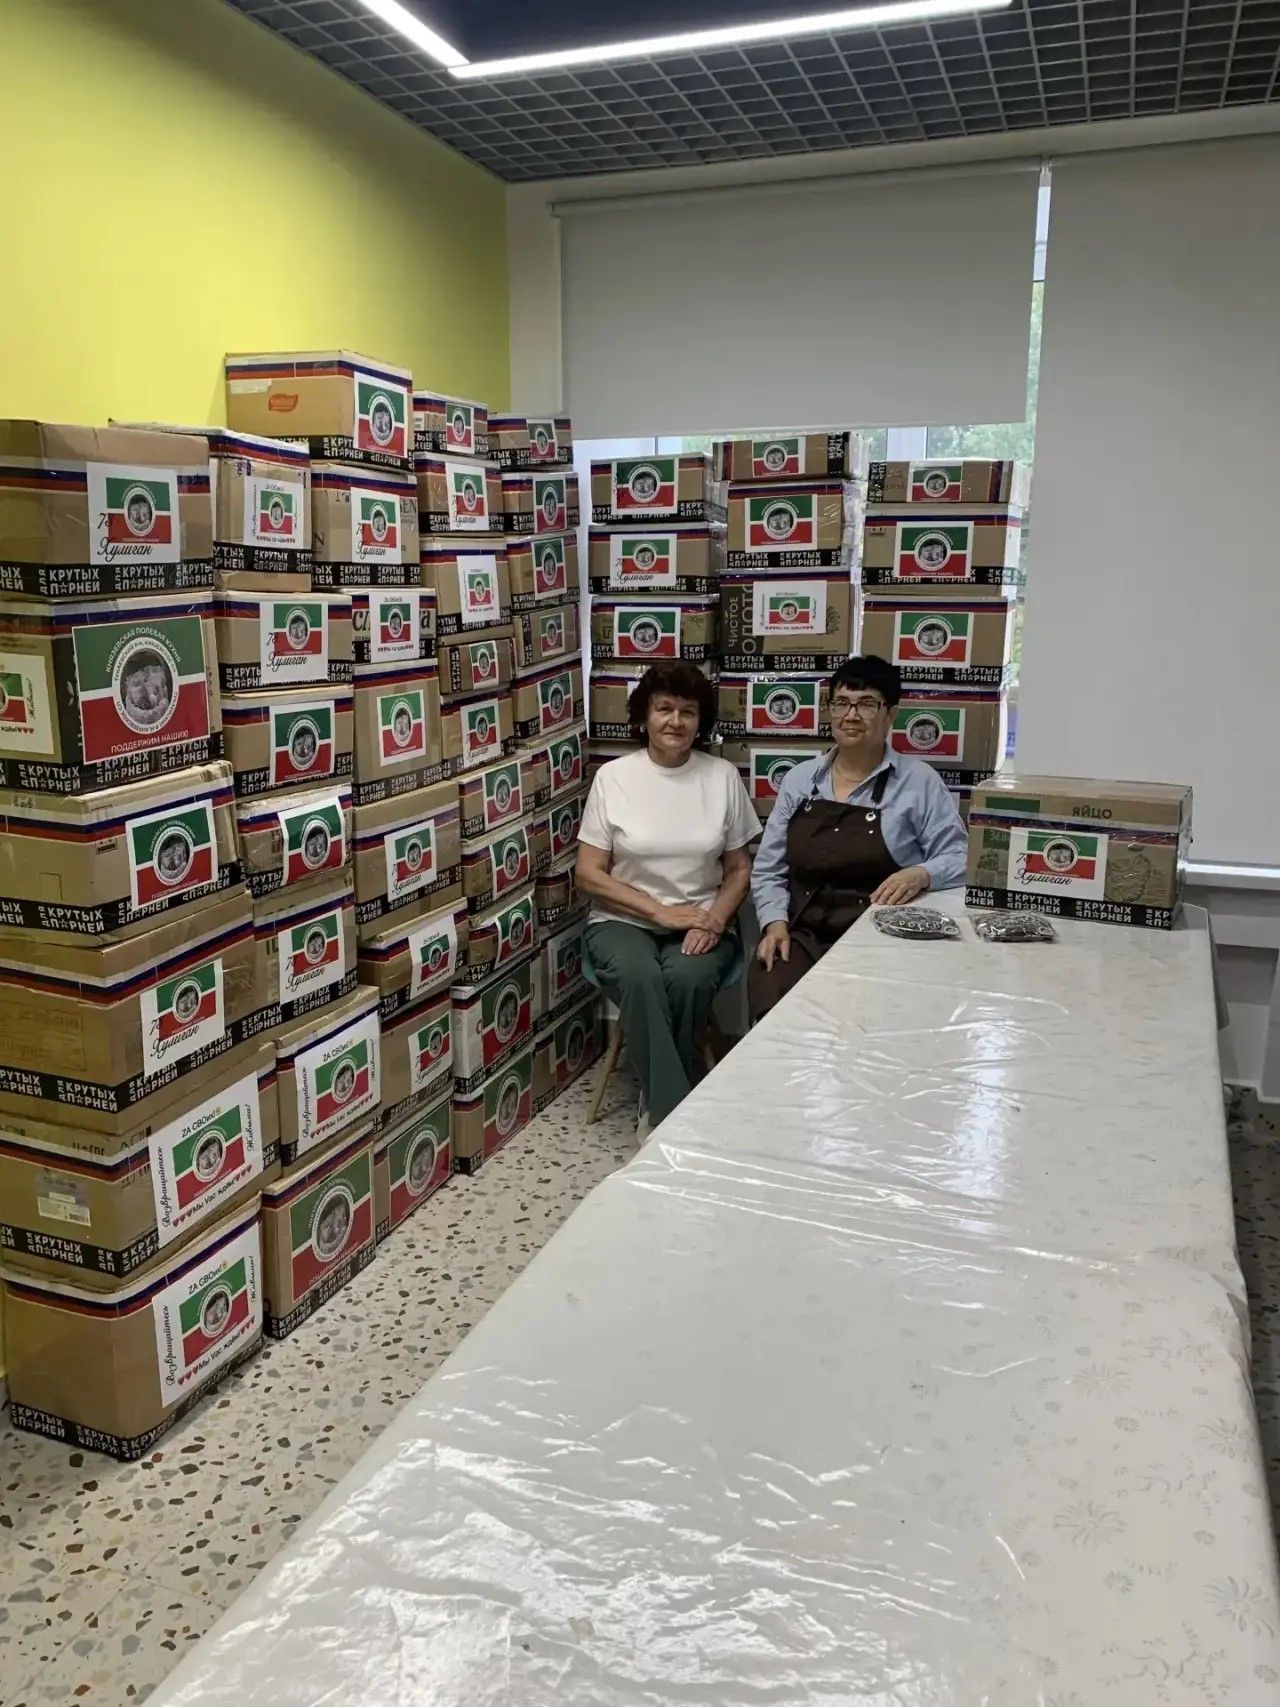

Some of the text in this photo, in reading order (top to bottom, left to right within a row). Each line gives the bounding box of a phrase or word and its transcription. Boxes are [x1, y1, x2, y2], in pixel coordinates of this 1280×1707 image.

[97, 536, 152, 562] Хулиган
[50, 568, 100, 582] КРУТЫХ
[122, 566, 165, 577] КРУТЫХ
[182, 563, 213, 575] КРУТЫ
[728, 597, 739, 647] ЧИСТОЕ
[234, 668, 261, 678] КРУТЫ
[961, 667, 1000, 675] КРУТЫХ
[111, 730, 189, 753] ПОДДЕРЖИМ НАШИХ!
[28, 765, 80, 779] КРУТЫХ
[1072, 805, 1113, 819] ЯЙЦО
[1014, 868, 1073, 885] Хулиган
[1015, 894, 1060, 905] КРУТЫХ
[48, 907, 103, 921] КРУТЫХ
[1084, 902, 1132, 914] КРУТЫХ
[0, 1070, 40, 1086] РУТЫХ
[66, 1083, 116, 1100] КРУТЫХ
[181, 1128, 191, 1138] ZA
[34, 1236, 81, 1254] КРУТЫХ
[18, 1407, 63, 1427] КРУТЫХ
